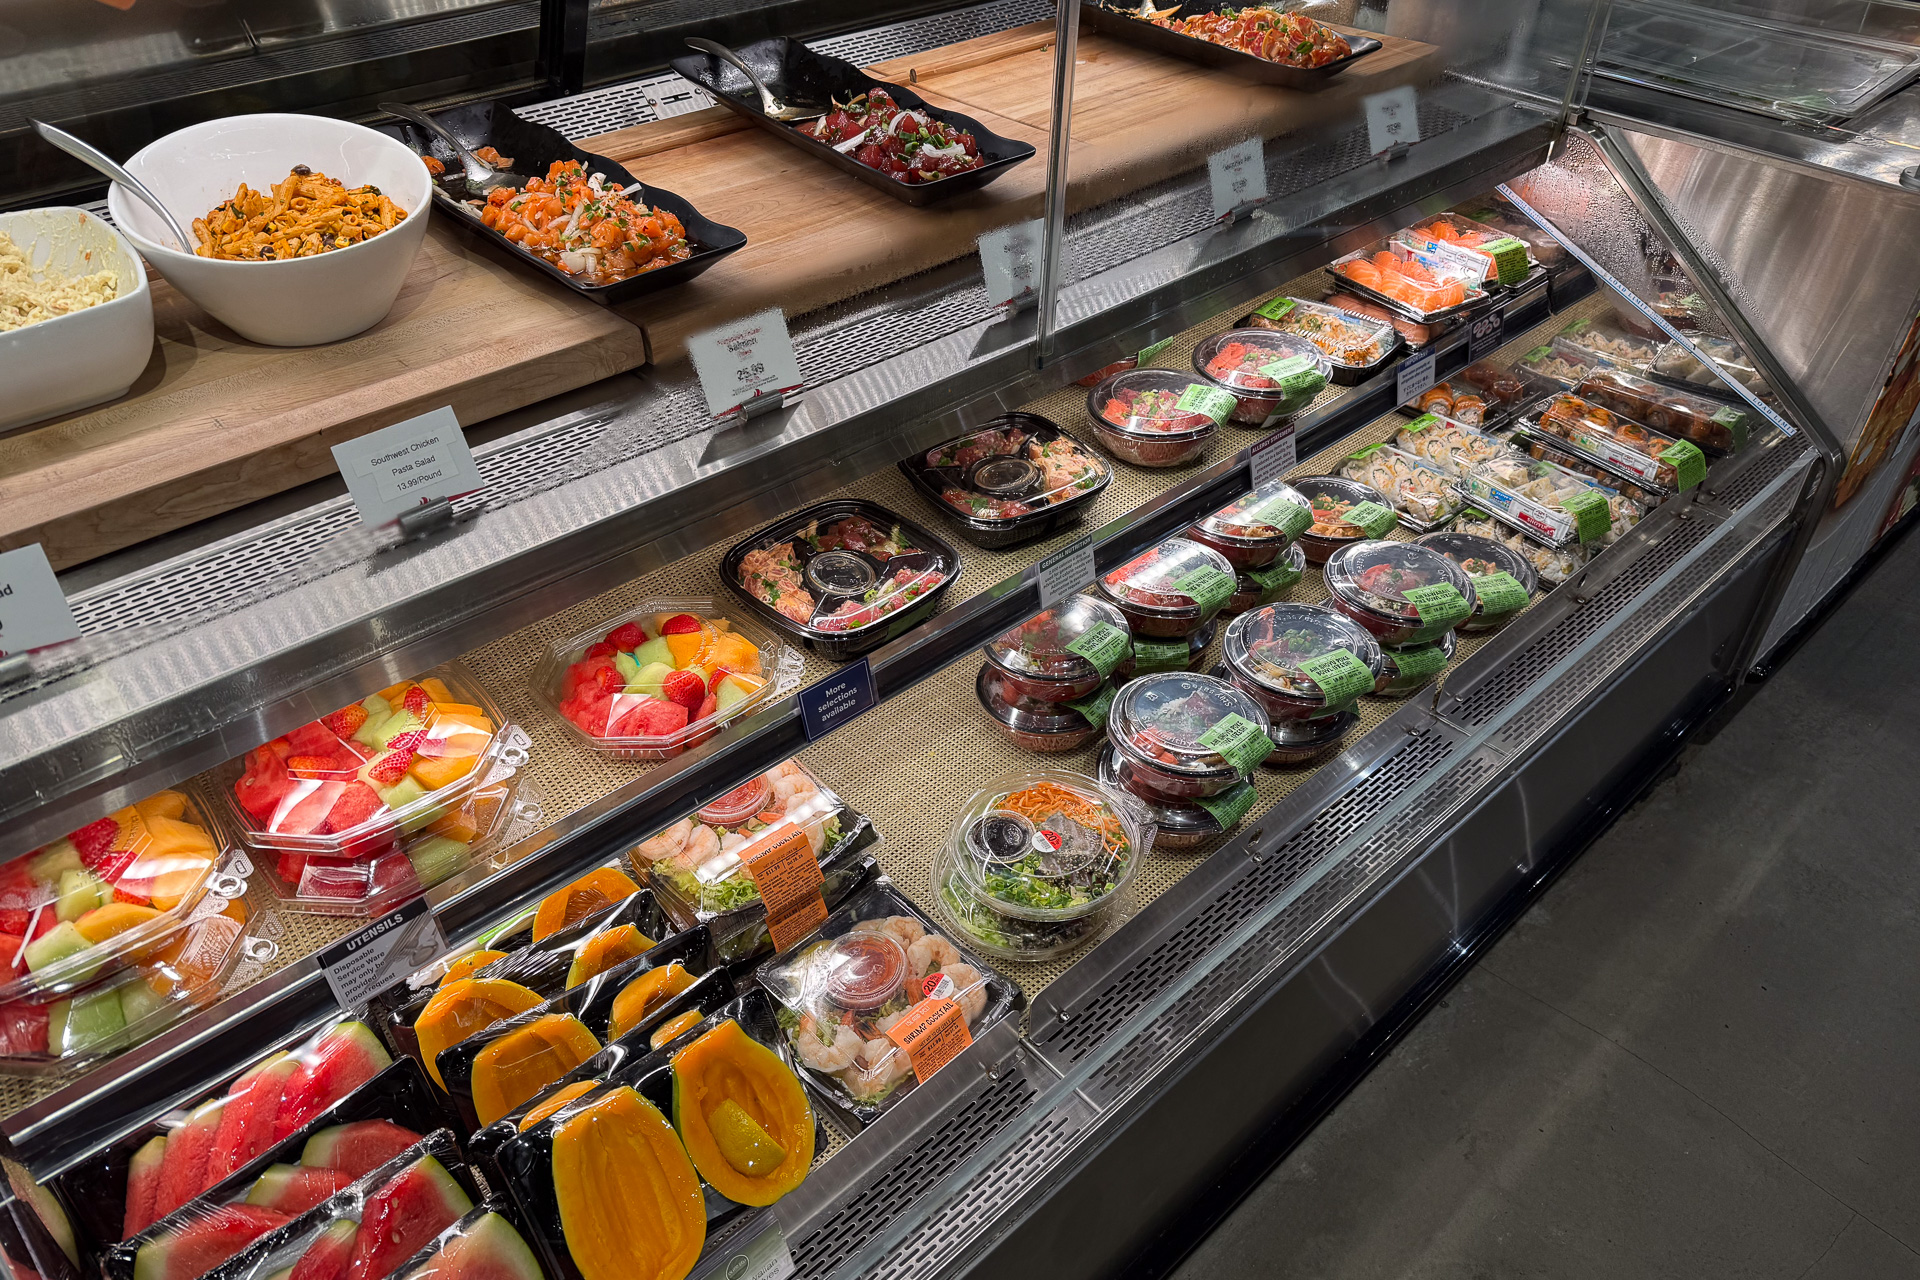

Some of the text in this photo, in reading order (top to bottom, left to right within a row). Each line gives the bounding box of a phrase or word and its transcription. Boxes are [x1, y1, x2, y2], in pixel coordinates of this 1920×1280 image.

[1608, 276, 1648, 310] LOAD LIMIT
[1753, 397, 1796, 434] LOAD LIMIT
[370, 435, 440, 467] Southwest Chicken
[1252, 426, 1294, 453] ALLERGY STATEMENT
[391, 454, 436, 477] Pasta Salad
[396, 469, 442, 492] 13.99/Pound
[1042, 536, 1091, 568] GENERAL NUTRITION
[817, 687, 858, 713] selections
[825, 682, 846, 698] More
[822, 699, 856, 722] available
[346, 913, 404, 951] UTENSILS
[333, 947, 375, 975] Disposable
[337, 951, 385, 982] Service Ware
[341, 960, 385, 990] may only be
[344, 974, 378, 998] provided
[348, 972, 396, 1004] upon request
[903, 1023, 927, 1045] SHRIMP
[926, 1002, 954, 1026] COCKTAIL
